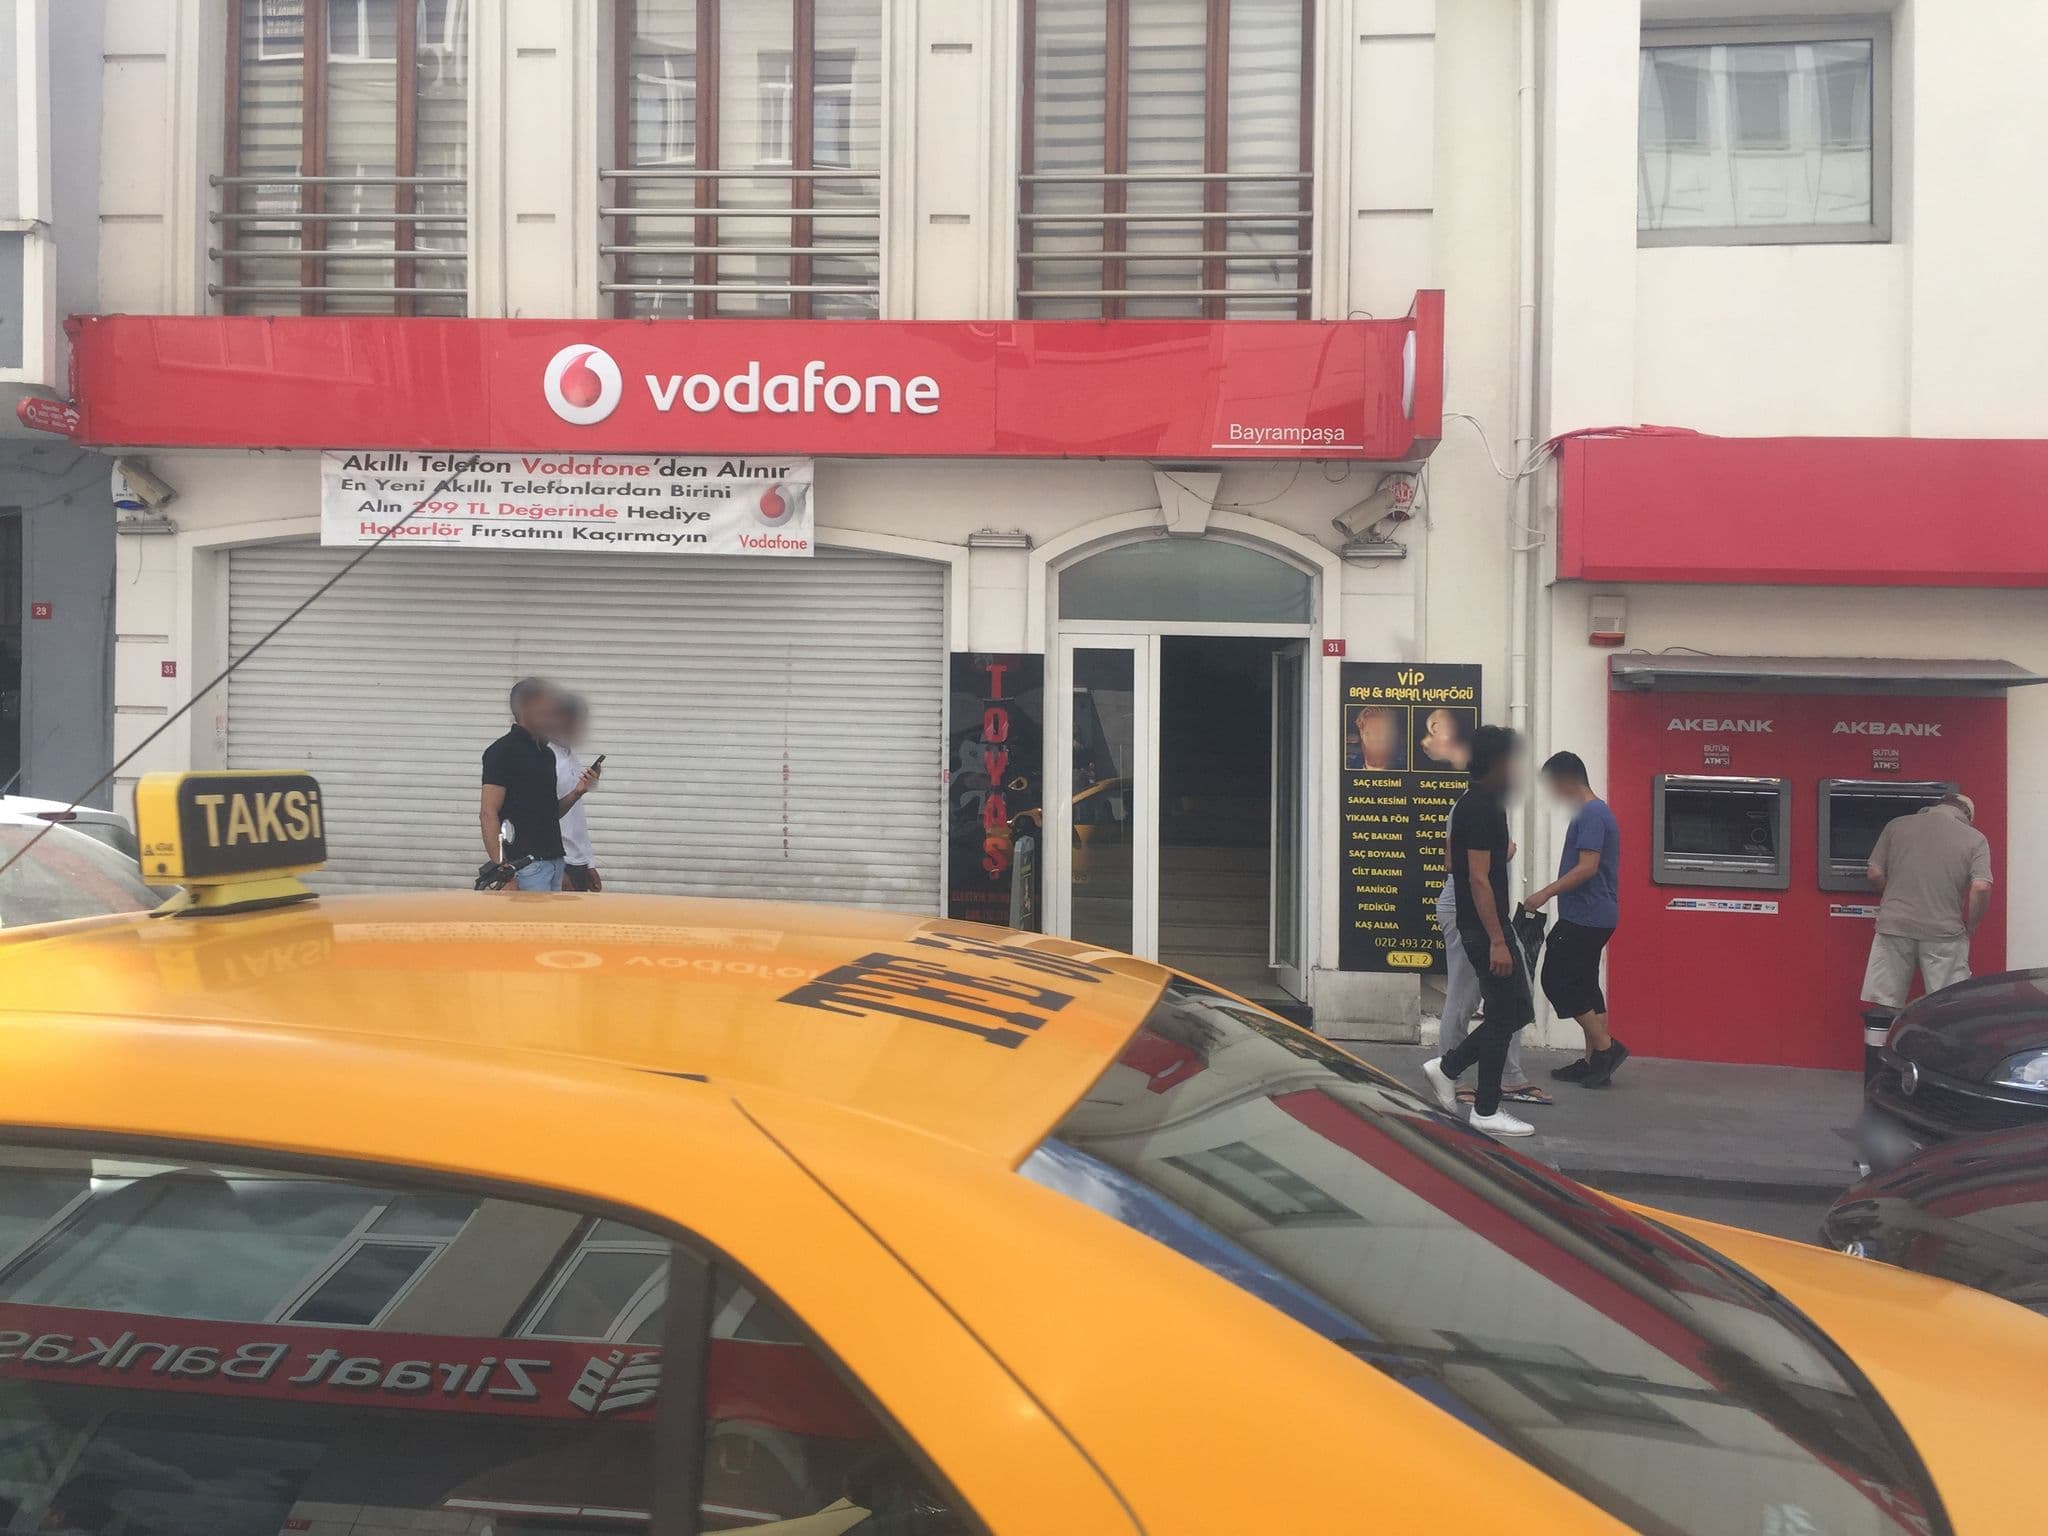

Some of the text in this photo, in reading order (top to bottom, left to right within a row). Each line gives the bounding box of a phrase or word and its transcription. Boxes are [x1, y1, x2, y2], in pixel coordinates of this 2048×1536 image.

[645, 360, 940, 414] vodafone
[1230, 424, 1345, 444] Bayrampaşa
[343, 454, 408, 472] Akıllı
[418, 455, 511, 473] Telefon
[717, 459, 790, 478] Alınır
[341, 479, 731, 499] En Yeni Akıllı Telefonlardan Birini
[358, 500, 711, 524] Alın 299 TL Değerinde Hediye
[360, 522, 707, 546] Hoparlör Fırsatını Kaçırmayın
[739, 534, 807, 550] Vodafone
[1328, 643, 1339, 653] 31
[1397, 668, 1425, 686] VİP
[1349, 686, 1473, 702] BAY & BAYAN KUAFÖRÜ
[1667, 718, 1773, 732] AKBANK
[1832, 721, 1942, 737] AKBANK
[1353, 778, 1402, 788] SAÇ KESİMİ
[1420, 780, 1437, 790] SAÇ
[1348, 796, 1407, 805] SAKAL KESİMİ
[1412, 797, 1448, 806] YIKAMA
[1345, 814, 1409, 823] YIKAMA & FÖN
[1419, 813, 1437, 823] SAÇ
[1352, 832, 1402, 841] SAÇ BAKIMI
[1415, 831, 1433, 840] SAÇ
[1348, 850, 1406, 859] SAÇ BOYAMA
[1352, 866, 1402, 876] CİLT BAKIMI
[1356, 885, 1398, 895] MANİKÜR
[1358, 903, 1396, 912] PEDİKÜR
[1355, 921, 1399, 930] KAŞ ALMA
[1374, 937, 1397, 947] 0212
[1399, 938, 1418, 948] 493
[1420, 939, 1432, 949] 22
[1392, 954, 1414, 963] KAT
[1423, 956, 1429, 964] 2
